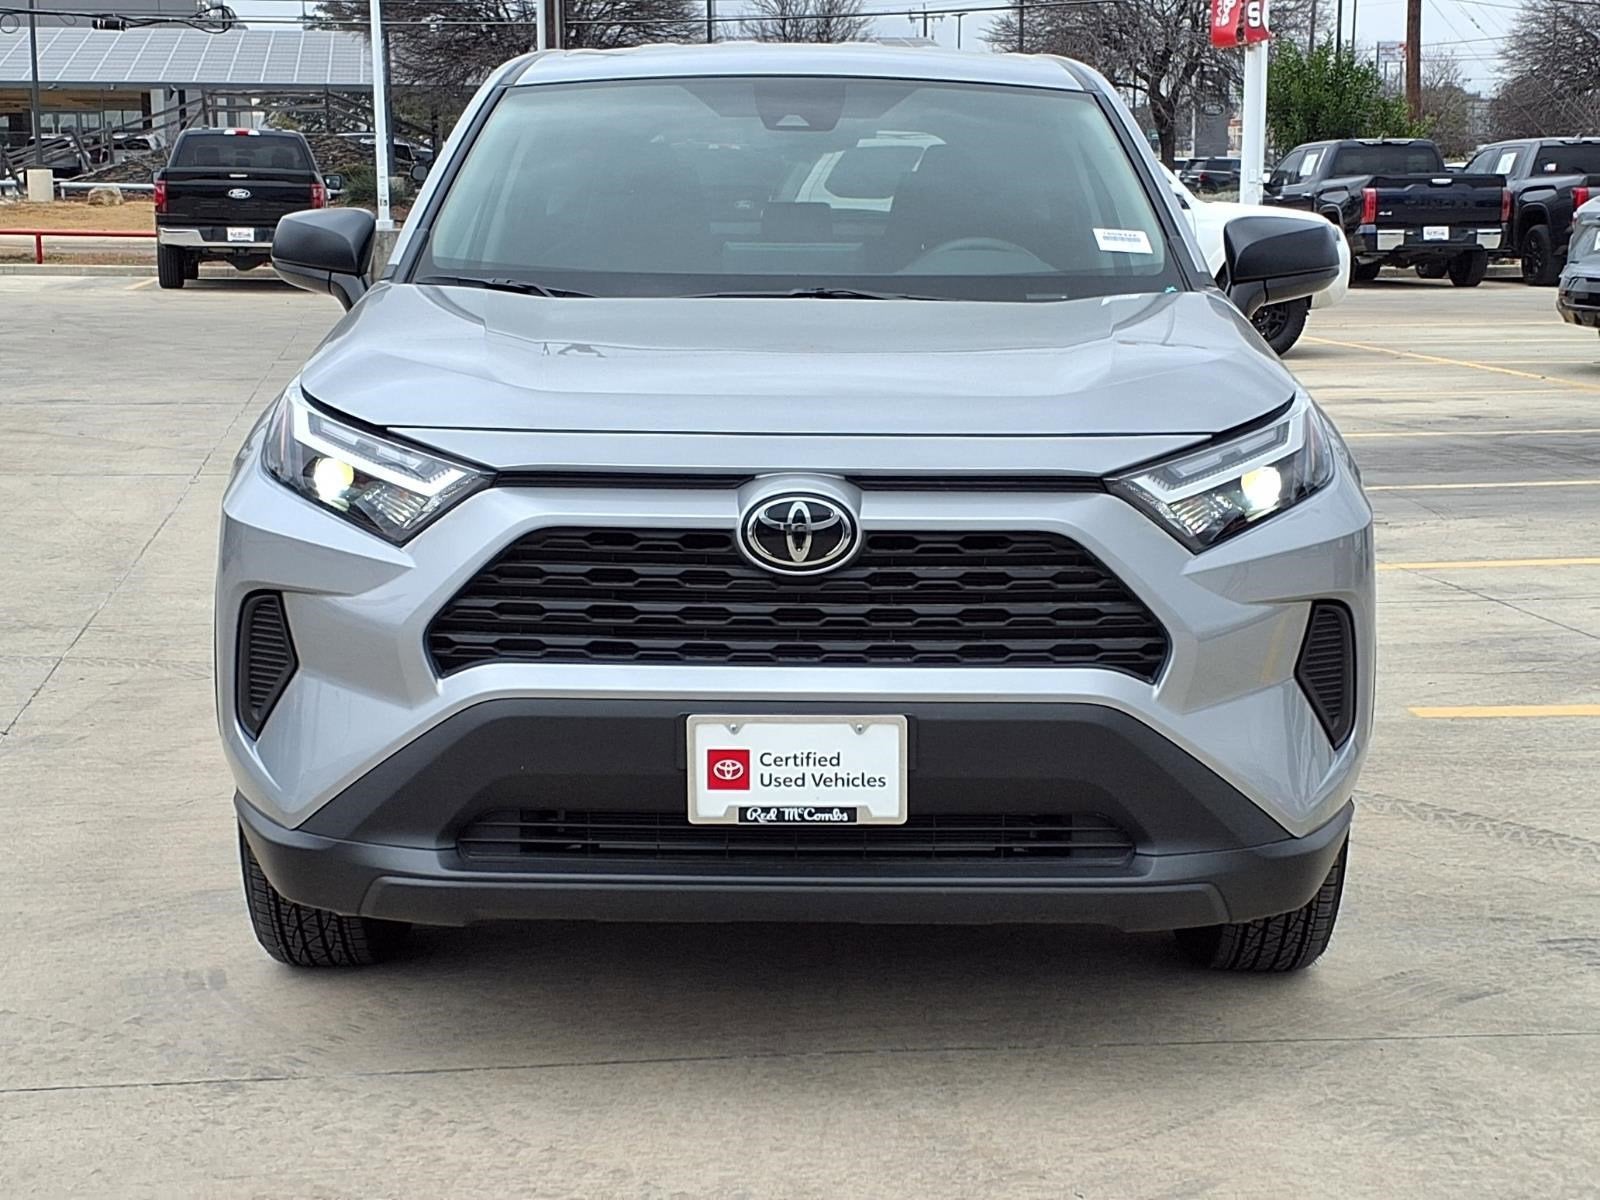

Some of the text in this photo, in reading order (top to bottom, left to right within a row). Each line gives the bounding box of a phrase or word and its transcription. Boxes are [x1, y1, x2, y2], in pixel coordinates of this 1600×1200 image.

[759, 751, 841, 767] Certified
[759, 772, 886, 788] Used Vehicles
[746, 807, 849, 823] Red McCombs
